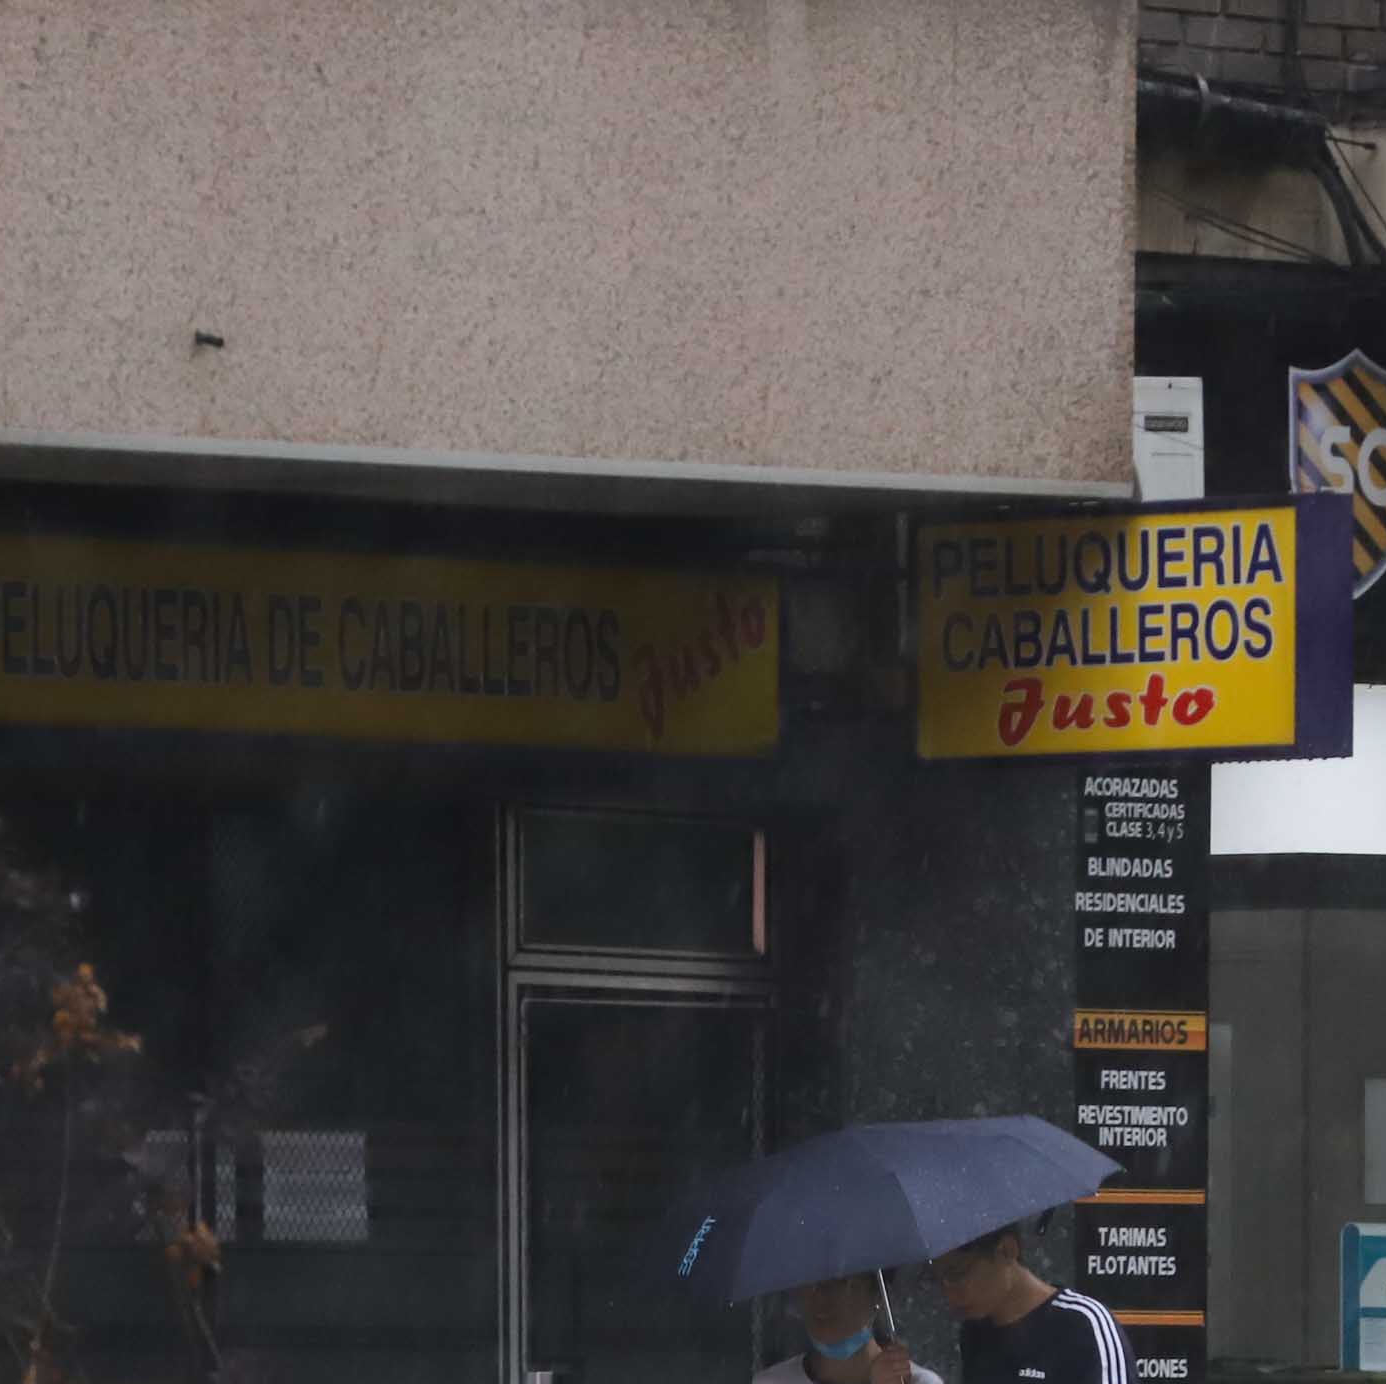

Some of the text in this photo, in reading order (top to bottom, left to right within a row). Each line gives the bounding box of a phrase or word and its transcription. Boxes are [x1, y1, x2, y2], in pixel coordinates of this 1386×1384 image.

[931, 522, 1285, 599] PELUQUERIA
[941, 597, 1275, 672] CABALLEROS
[265, 594, 326, 689] DE
[337, 599, 621, 702] CABALLEROS
[630, 586, 767, 742] Justo
[997, 672, 1216, 748] Justo
[1084, 776, 1179, 799] ACORAZADAS
[1104, 801, 1186, 821] CERTIFICADAS
[1105, 821, 1144, 838] CLASE
[1086, 856, 1174, 879] BLINDADAS
[1075, 891, 1186, 915] RESIDENCIALES
[1084, 928, 1176, 949] DE INTERIOR
[1078, 1018, 1189, 1045] ARMARIOS
[1100, 1069, 1167, 1091] FRENTES
[1077, 1104, 1189, 1126] REVESTIMIENTO
[1099, 1127, 1167, 1147] INTERIOR
[1098, 1226, 1168, 1248] TARIMAS
[1087, 1254, 1177, 1276] FLOTANTES
[1135, 1358, 1189, 1379] CIONES
